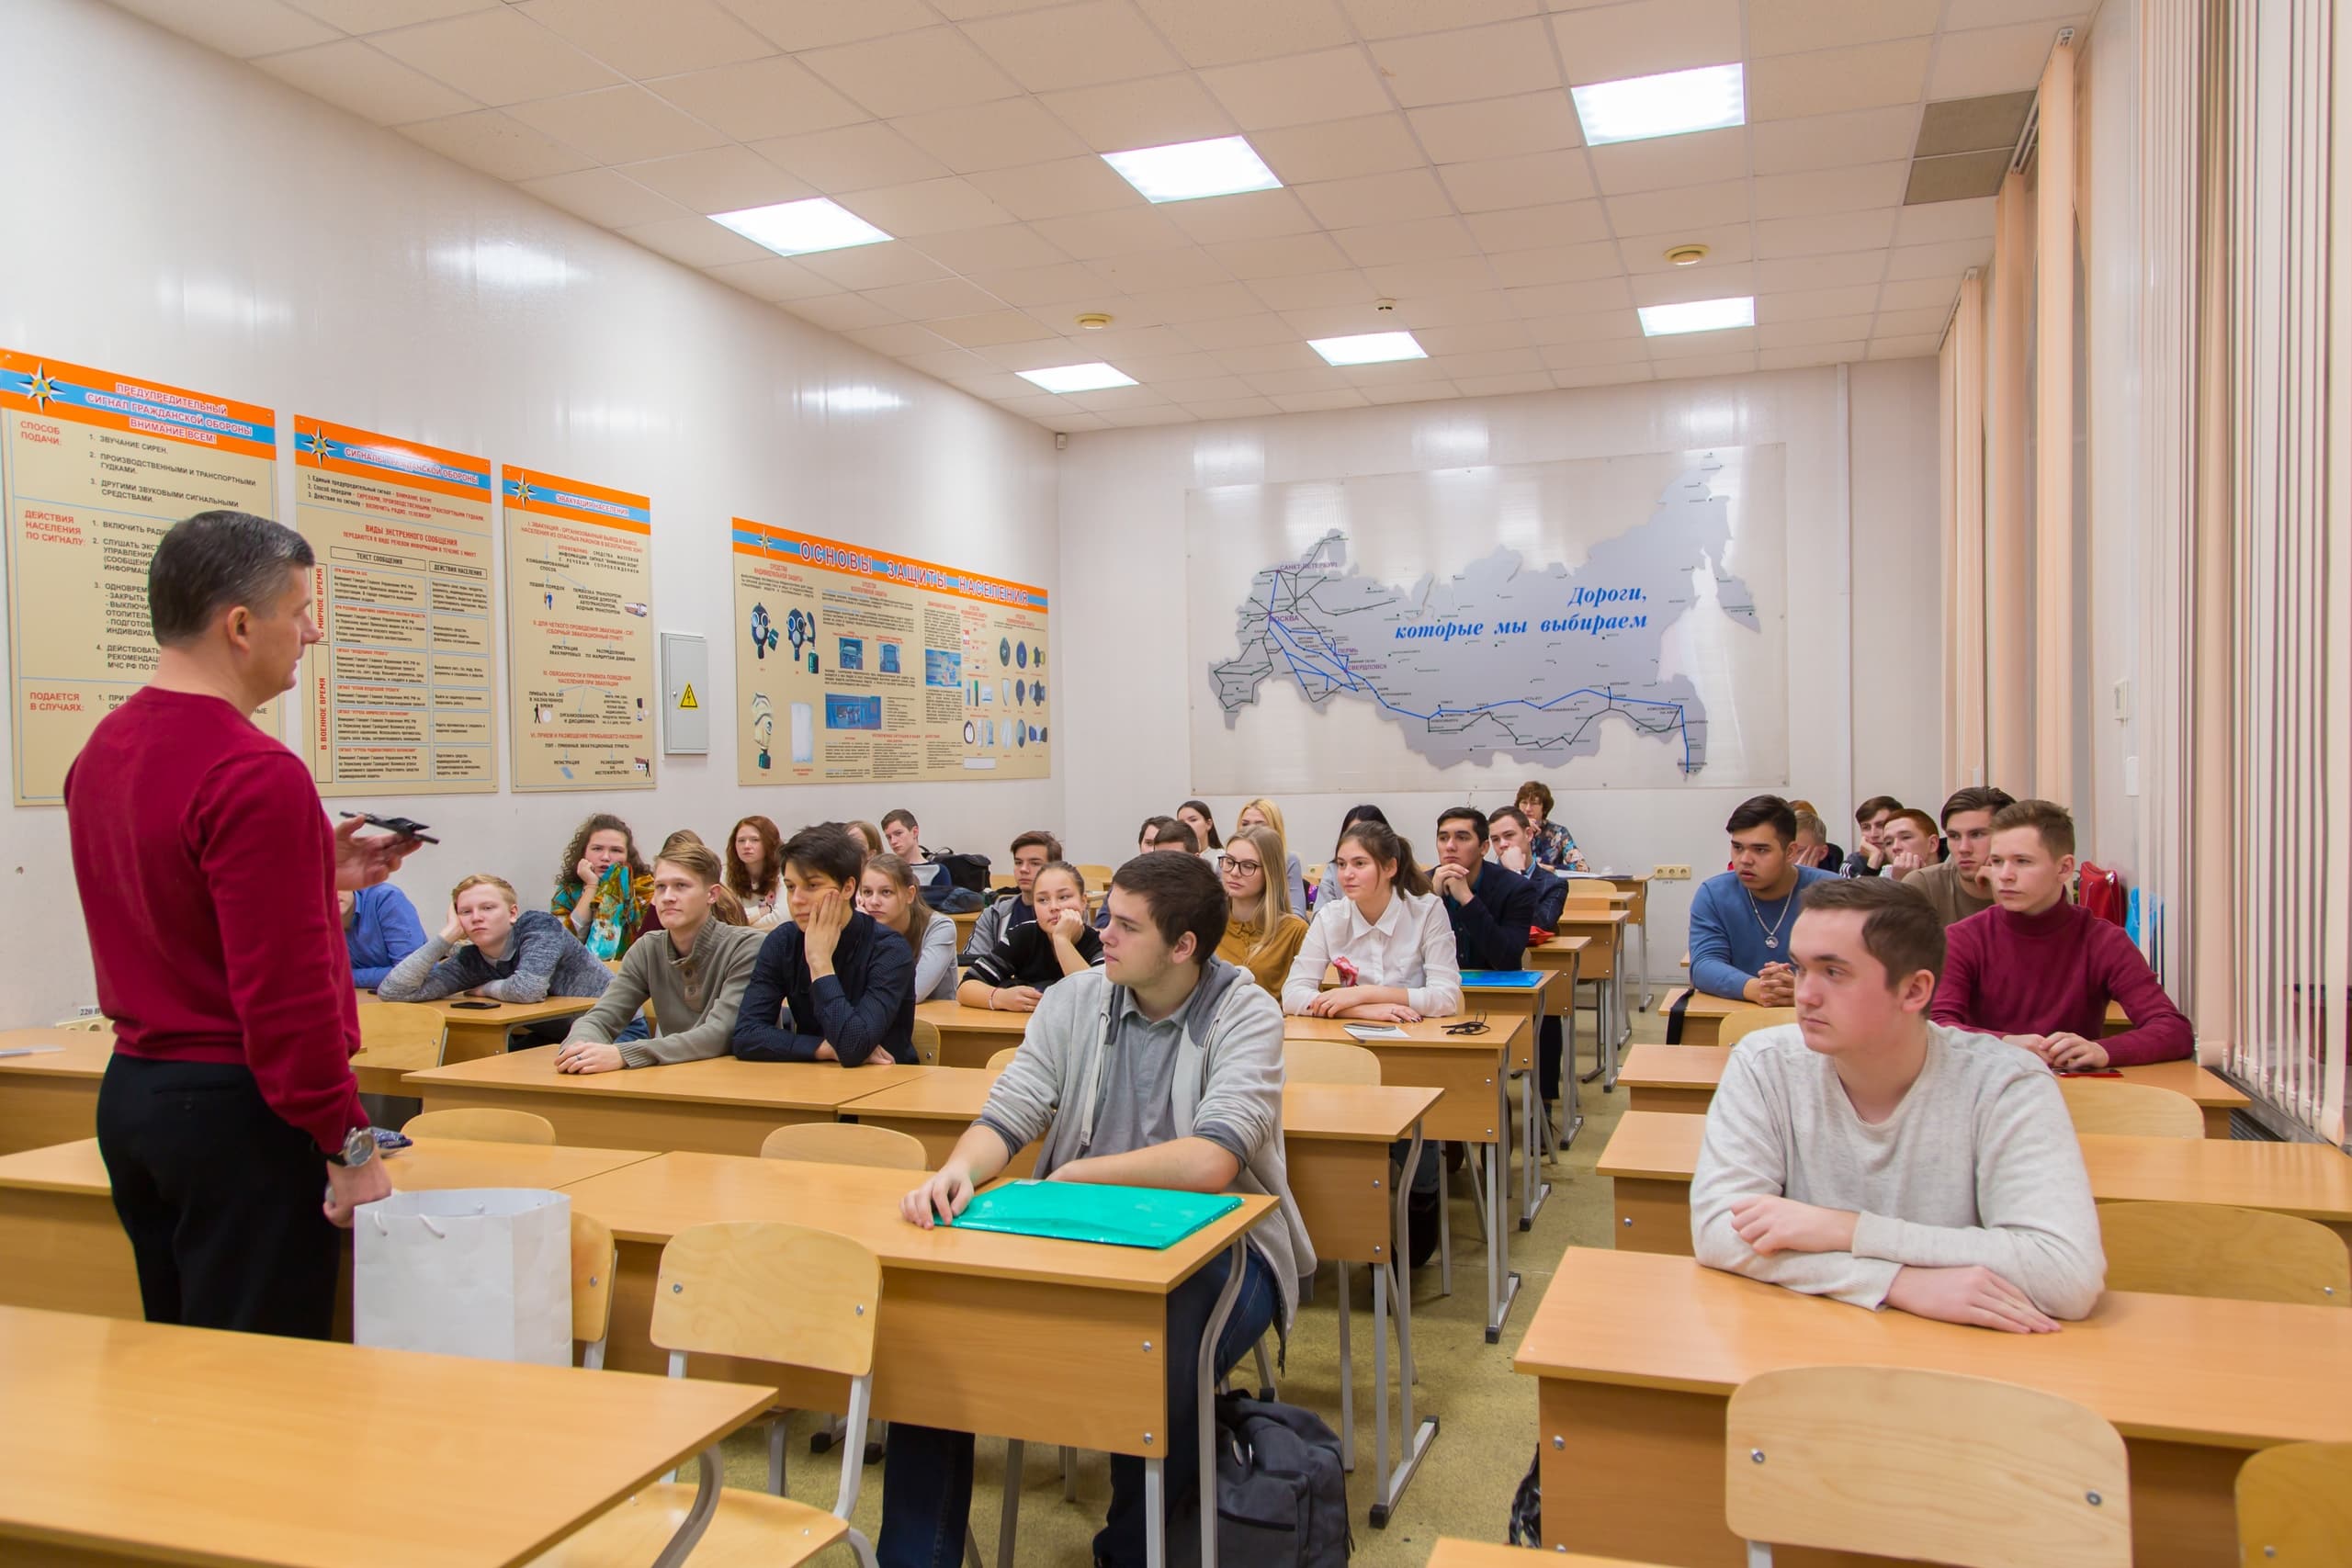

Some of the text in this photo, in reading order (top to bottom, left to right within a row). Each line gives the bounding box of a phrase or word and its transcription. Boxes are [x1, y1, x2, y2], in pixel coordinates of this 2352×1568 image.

[117, 384, 227, 414] ПРЕДУПРЕДИТЕЛЬНЫЙ
[86, 393, 252, 435] СИГНАЛ ГРАЖДАНСКОЙ ОБОРОНЫ
[20, 421, 61, 435] СПОСОБ
[130, 419, 216, 443] ВНИМАНИЕ ВСЕМ!
[100, 435, 140, 448] ЗВУЧАНИЕ
[141, 443, 168, 454] СИРЕН.
[100, 454, 187, 475] ПРОИЗВОДСТВЕННЫМИ
[196, 470, 255, 487] ТРАНСПОРТНЫМИ
[101, 463, 137, 474] ГУДКАМИ.
[345, 447, 384, 463] СИГНАЛЫ
[443, 469, 478, 484] ОБОРОНЫ
[101, 479, 137, 491] ДРУГИМИ
[139, 485, 184, 499] ЗВУКОВЫМИ
[186, 492, 239, 508] СИГНАЛЬНЫМИ
[101, 489, 153, 503] СРЕДСТВАМИ.
[557, 494, 628, 515] ЭВАКУАЦИЯ НАСЕЛЕНИЯ
[25, 509, 74, 524] ДЕЙСТВИЯ
[26, 521, 81, 535] НАСЕЛЕНИЯ
[103, 521, 144, 533] ВКЛЮЧИТЬ
[26, 531, 40, 540] ПО
[366, 525, 458, 546] ВИДЫ ЭКСТРЕННОГО СООБЩЕНИЯ
[103, 538, 139, 549] СЛУШАТЬ
[104, 556, 152, 567] (СООБЩЕНИ
[356, 552, 402, 565] ТЕКСТ СООБЩЕНИЯ
[104, 564, 150, 575] ИНФОРМАЦ
[434, 564, 482, 577] ДЕЙСТВИЯ НАСЕЛЕНИЯ
[1280, 562, 1338, 570] САНКТ-ПЕТЕРБУРГ
[800, 541, 873, 574] ОСНОВЫ
[888, 559, 947, 589] ЗАЩИТЫ
[959, 575, 1029, 605] НАСЕЛЕНИЯ
[105, 582, 147, 593] ОДНОВРЕМ
[110, 592, 145, 602] ЗАКРЫТЬ
[1567, 587, 1647, 607] Дороги,
[110, 601, 149, 610] ВЫКЛЮЧИ
[106, 610, 151, 619] ОТОПИТЕЛЬ
[110, 618, 153, 628] ПОДГОТОВ
[1395, 614, 1647, 641] которые мы выбираем
[107, 626, 153, 637] ИНДИВИДУА
[107, 653, 160, 662] РЕКОМЕНДАЦ
[318, 677, 326, 702] ВРЕМЯ
[30, 692, 79, 701] ПОДАЕТСЯ
